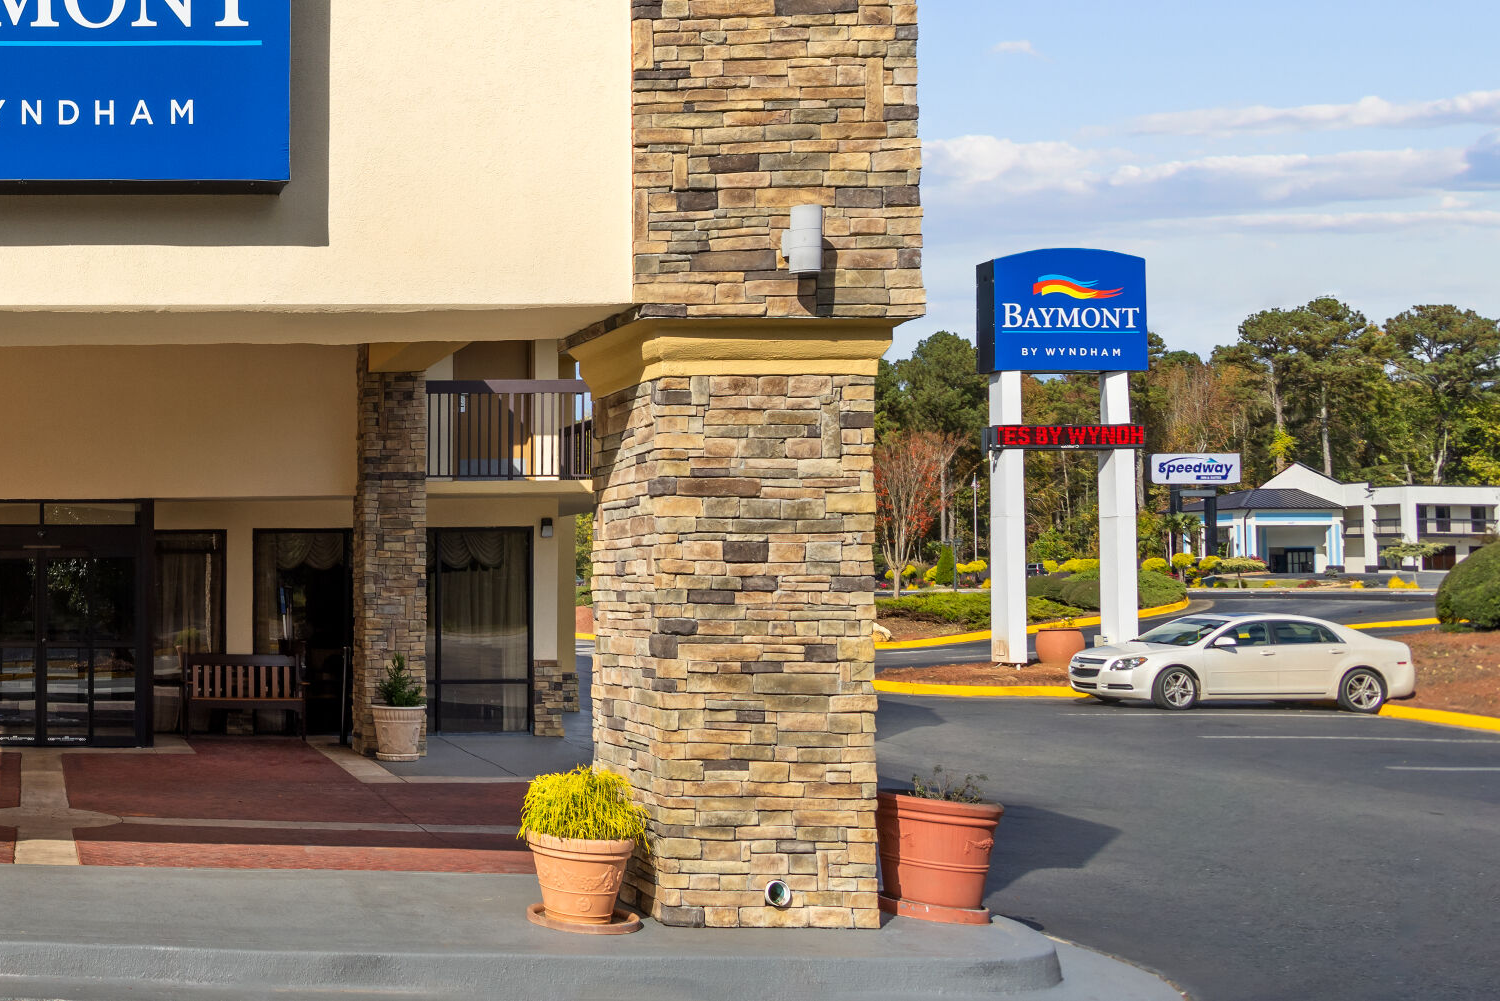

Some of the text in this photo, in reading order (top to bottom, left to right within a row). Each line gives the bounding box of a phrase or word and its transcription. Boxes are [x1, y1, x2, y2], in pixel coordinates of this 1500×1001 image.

[1001, 302, 1140, 329] BAYMONT
[1021, 347, 1122, 357] BY WYNDHAM
[1035, 426, 1063, 446] BY
[1067, 425, 1144, 446] WYNDH
[1158, 462, 1234, 481] Speedway
